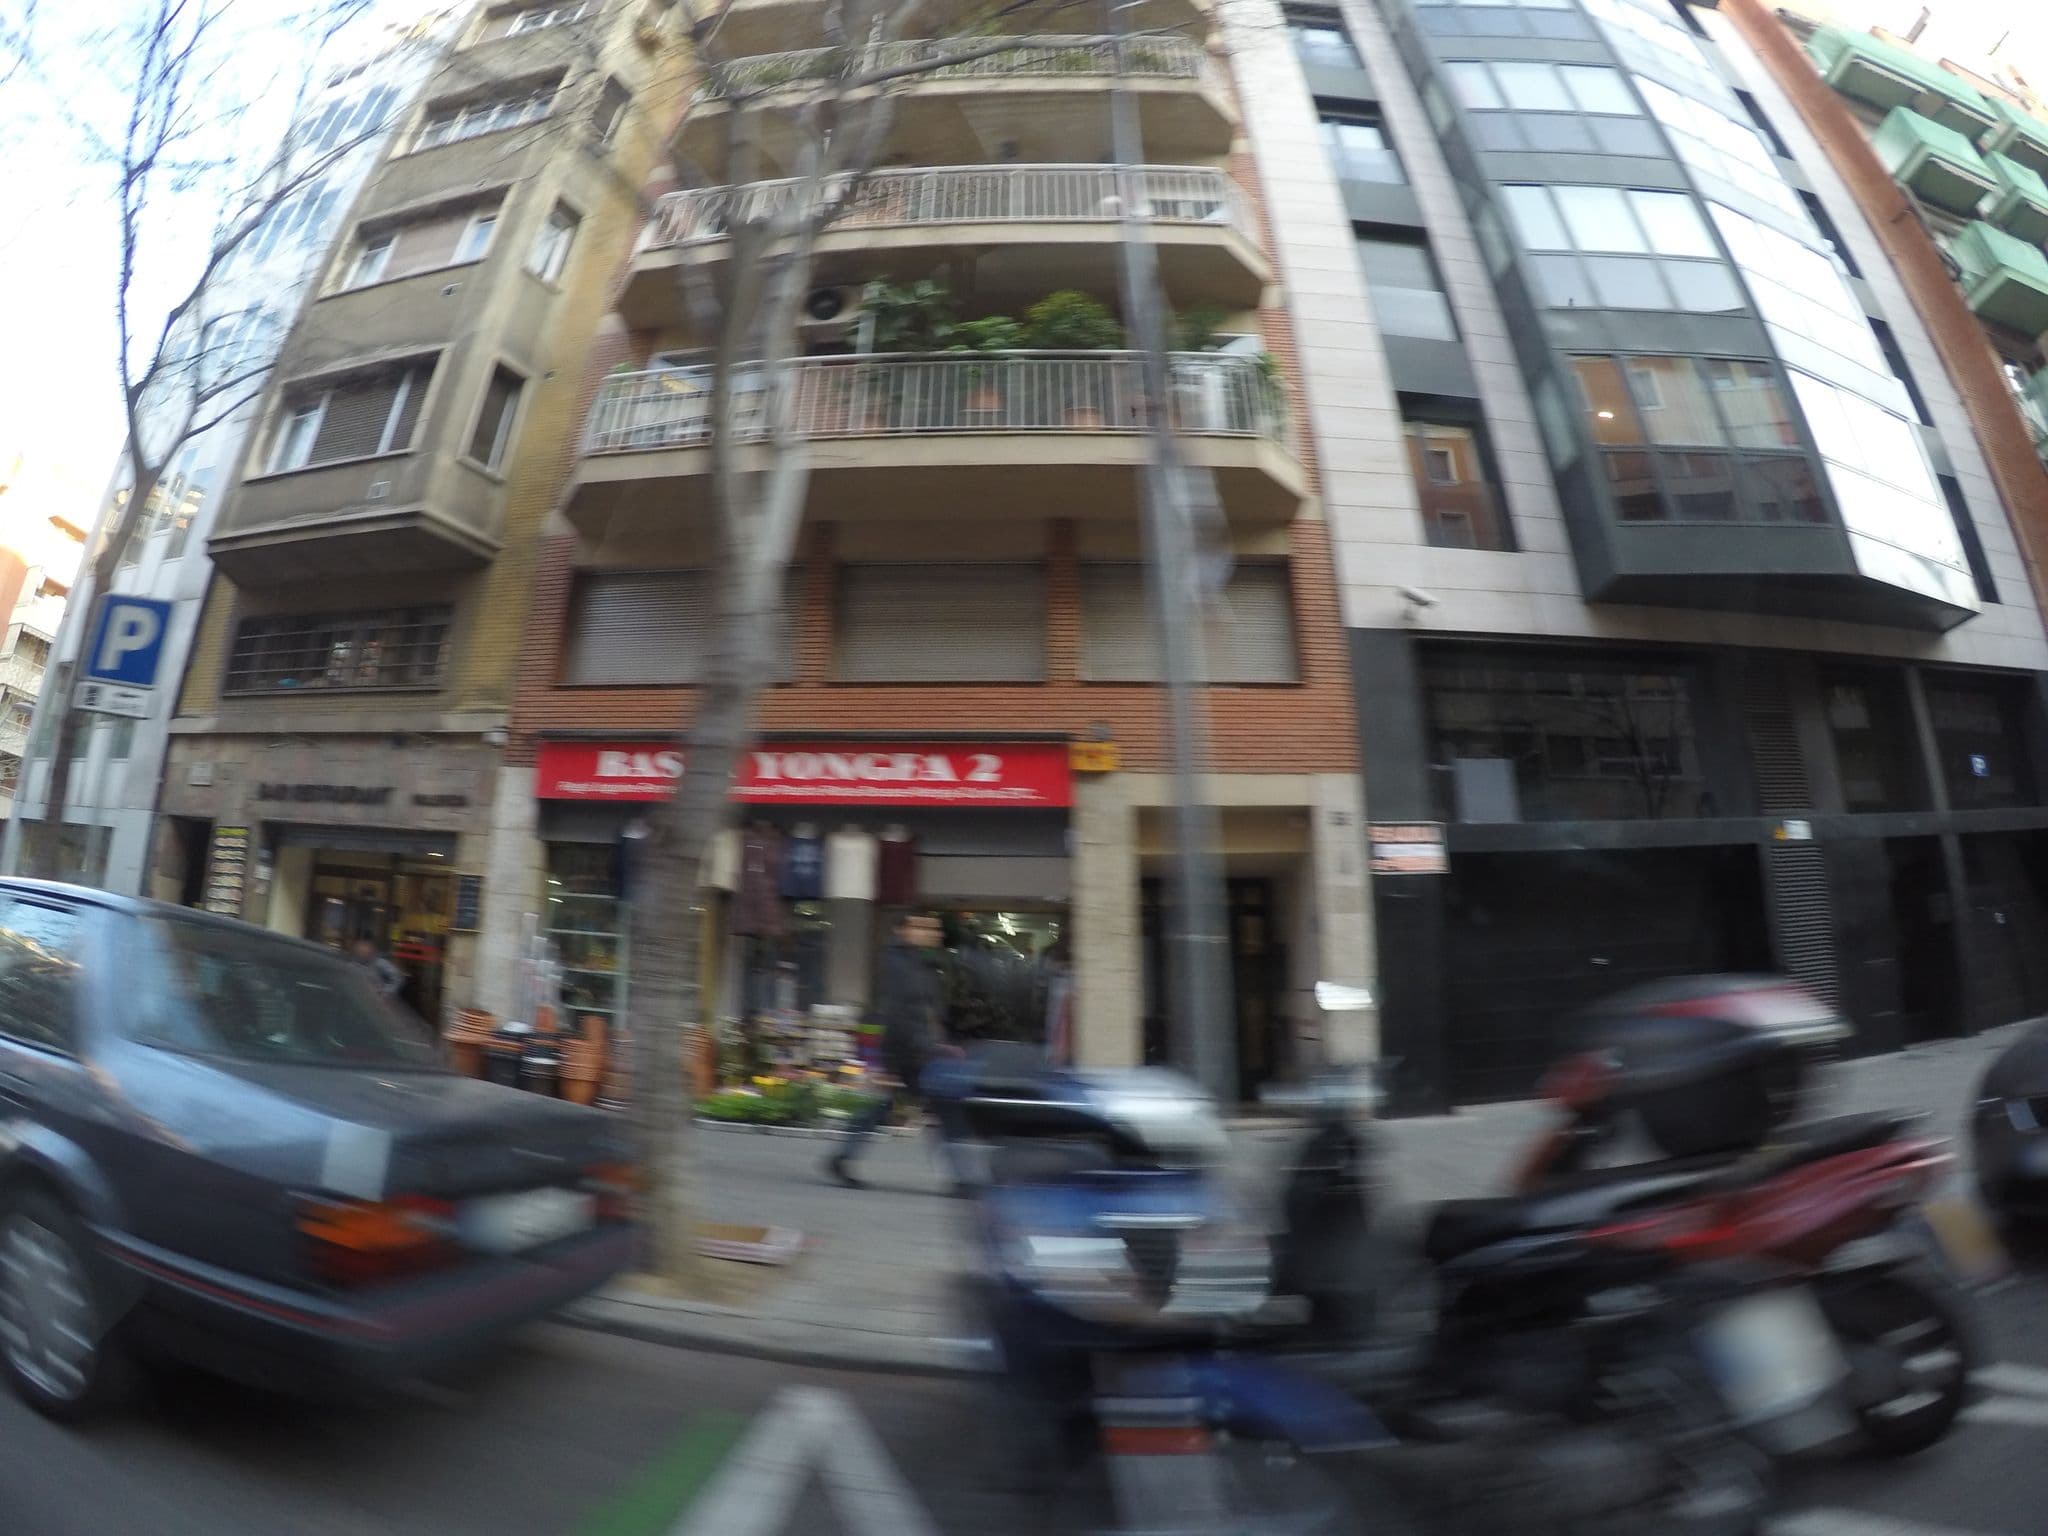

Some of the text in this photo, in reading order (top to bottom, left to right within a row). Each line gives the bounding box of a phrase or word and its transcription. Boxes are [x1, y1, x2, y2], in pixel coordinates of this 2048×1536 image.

[97, 604, 159, 670] P
[595, 750, 737, 778] BAS
[963, 753, 1002, 782] 2
